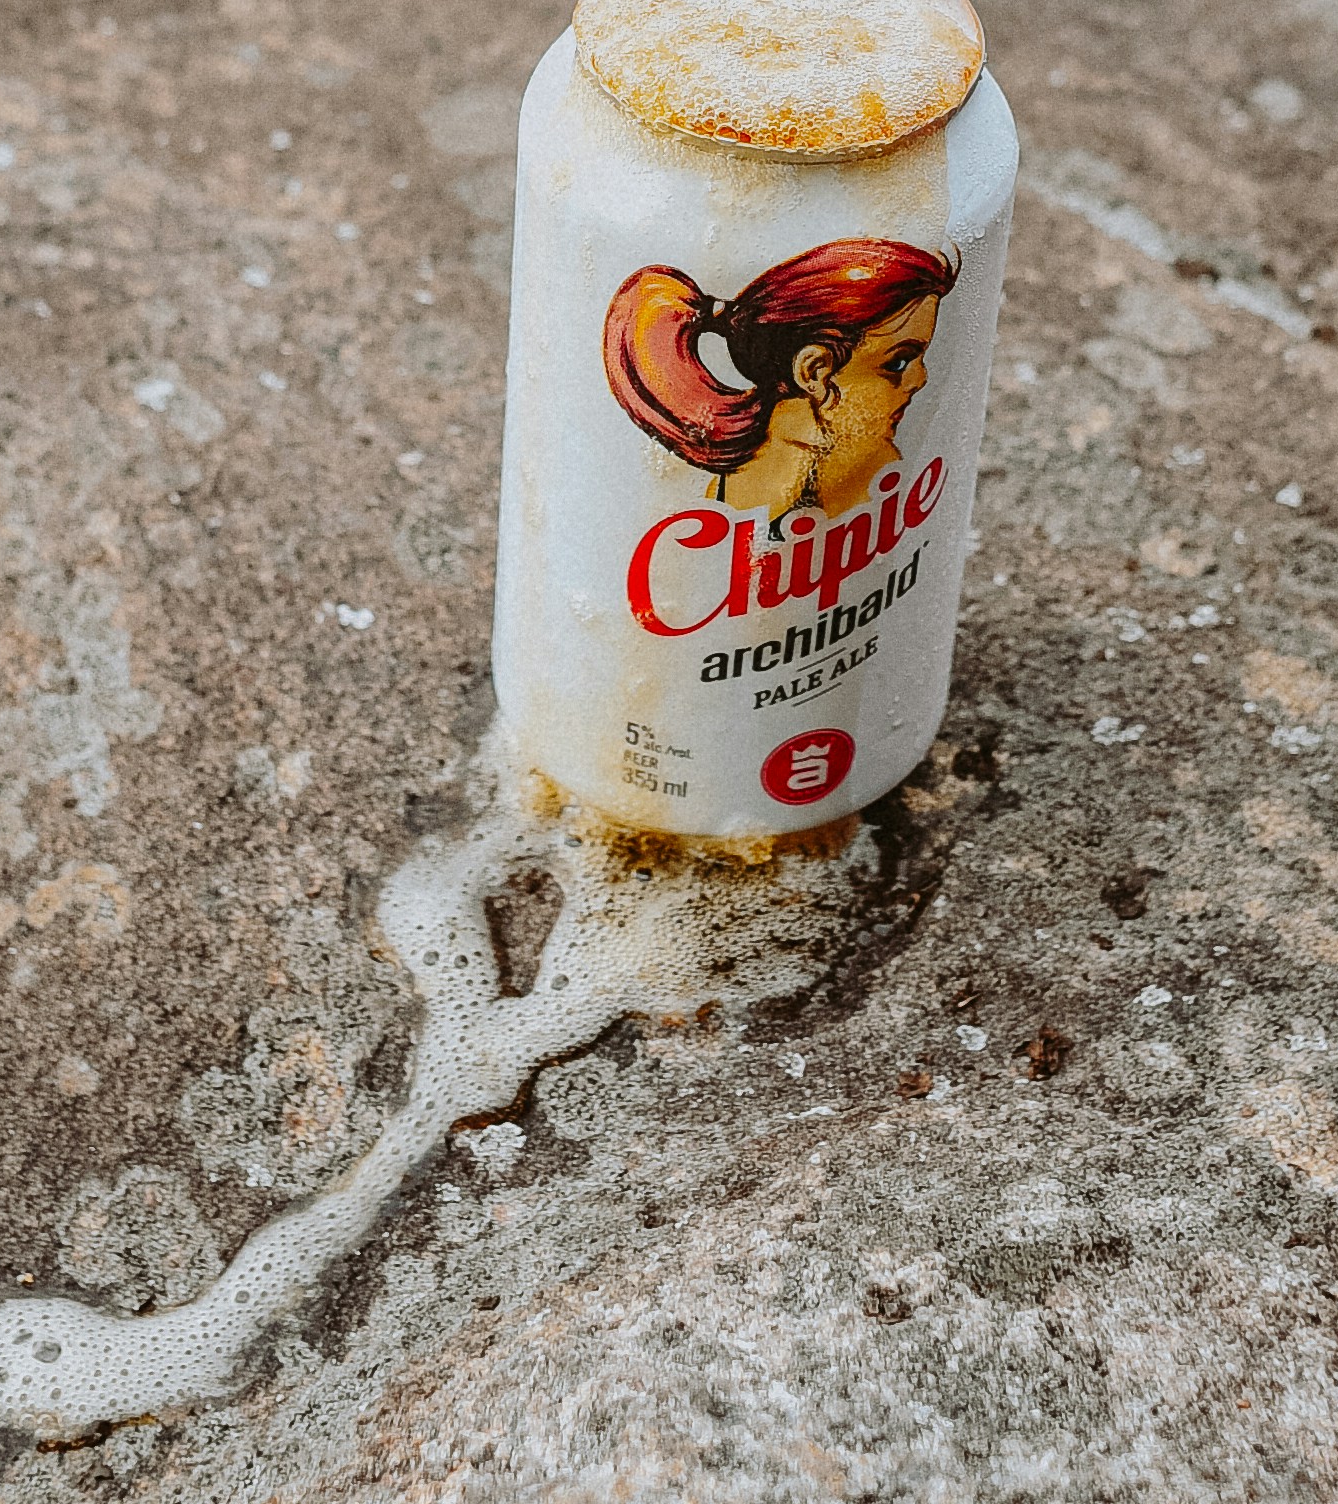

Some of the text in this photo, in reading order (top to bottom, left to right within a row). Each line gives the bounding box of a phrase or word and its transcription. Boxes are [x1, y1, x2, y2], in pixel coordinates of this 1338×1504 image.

[627, 456, 949, 637] Chipie
[700, 548, 921, 683] archibald
[753, 635, 879, 710] PALE ALE
[663, 781, 688, 798] ml
